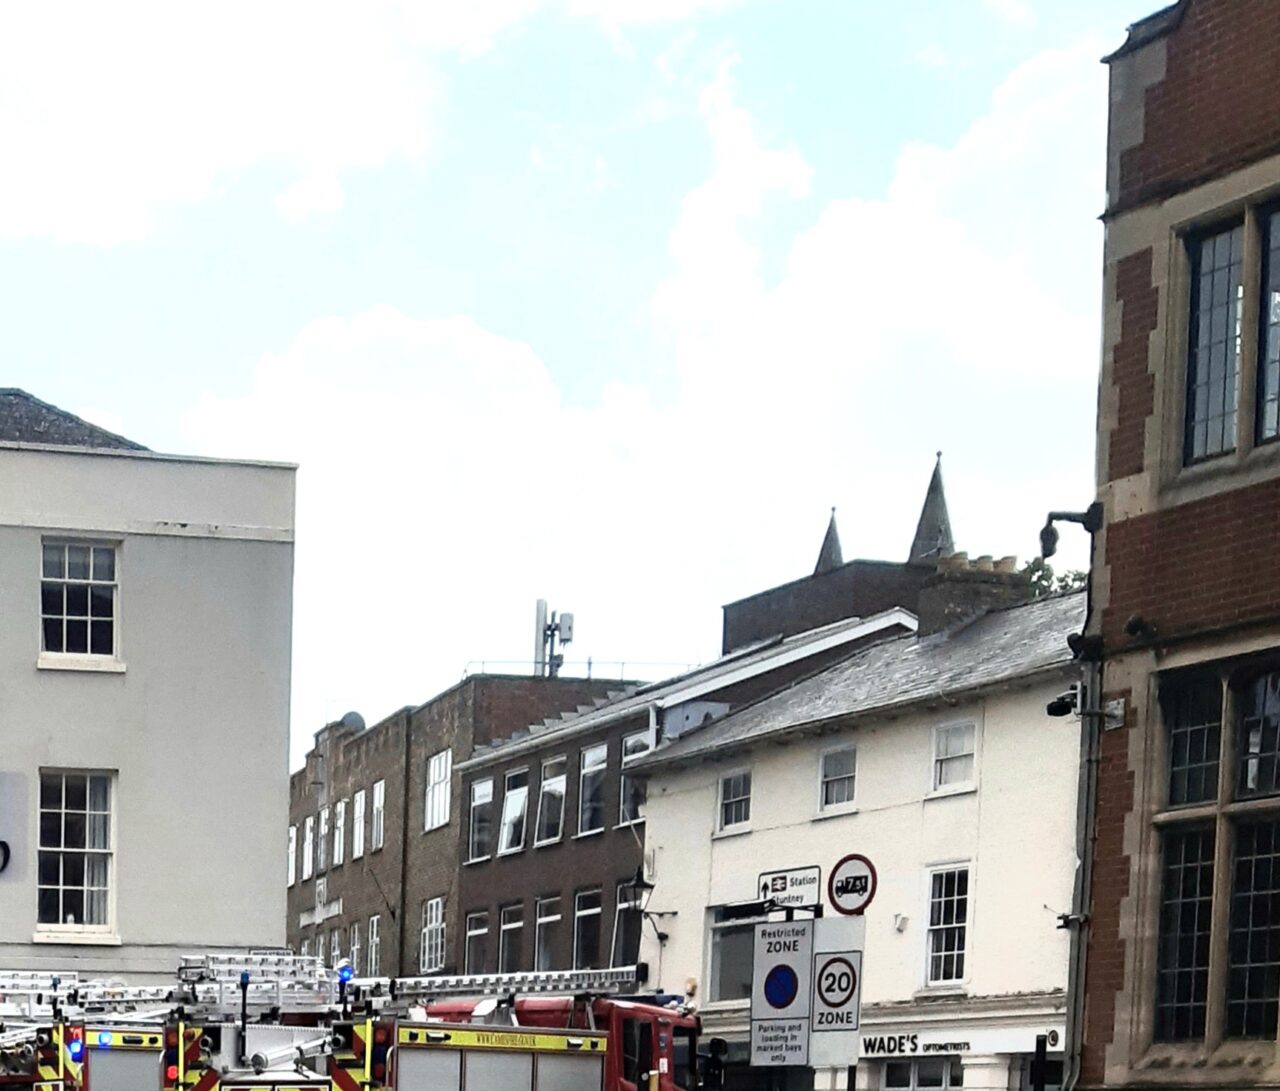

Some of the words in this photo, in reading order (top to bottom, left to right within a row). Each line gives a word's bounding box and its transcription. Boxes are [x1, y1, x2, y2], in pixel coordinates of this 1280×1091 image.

[789, 876, 817, 888] Station
[761, 927, 806, 939] Restricted
[766, 940, 799, 953] ZONE
[824, 972, 851, 993] 20
[817, 1012, 853, 1025] ZONE
[758, 1024, 786, 1033] Parking
[788, 1023, 802, 1032] and
[790, 1033, 797, 1041] in
[863, 1034, 918, 1055] WADE'S
[770, 1053, 786, 1063] only
